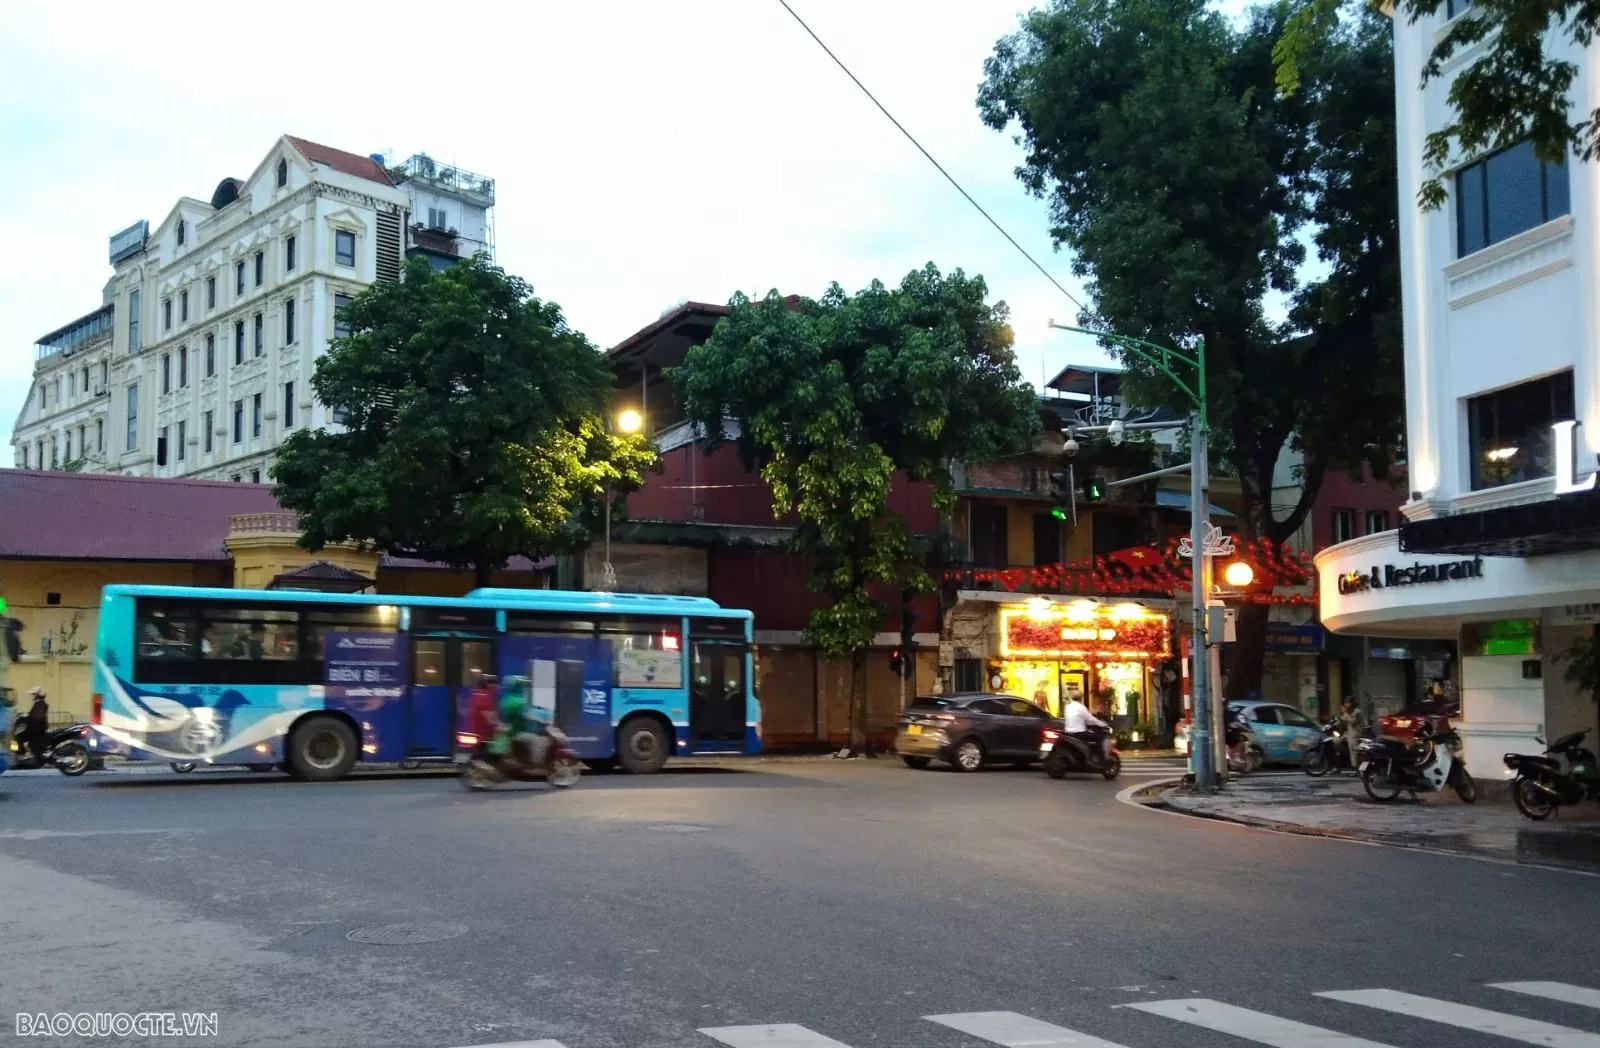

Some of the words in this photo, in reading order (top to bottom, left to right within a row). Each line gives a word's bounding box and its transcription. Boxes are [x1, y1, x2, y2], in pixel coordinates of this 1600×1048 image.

[1551, 420, 1597, 495] L
[1371, 566, 1383, 588] &
[1384, 554, 1483, 587] Restaurant
